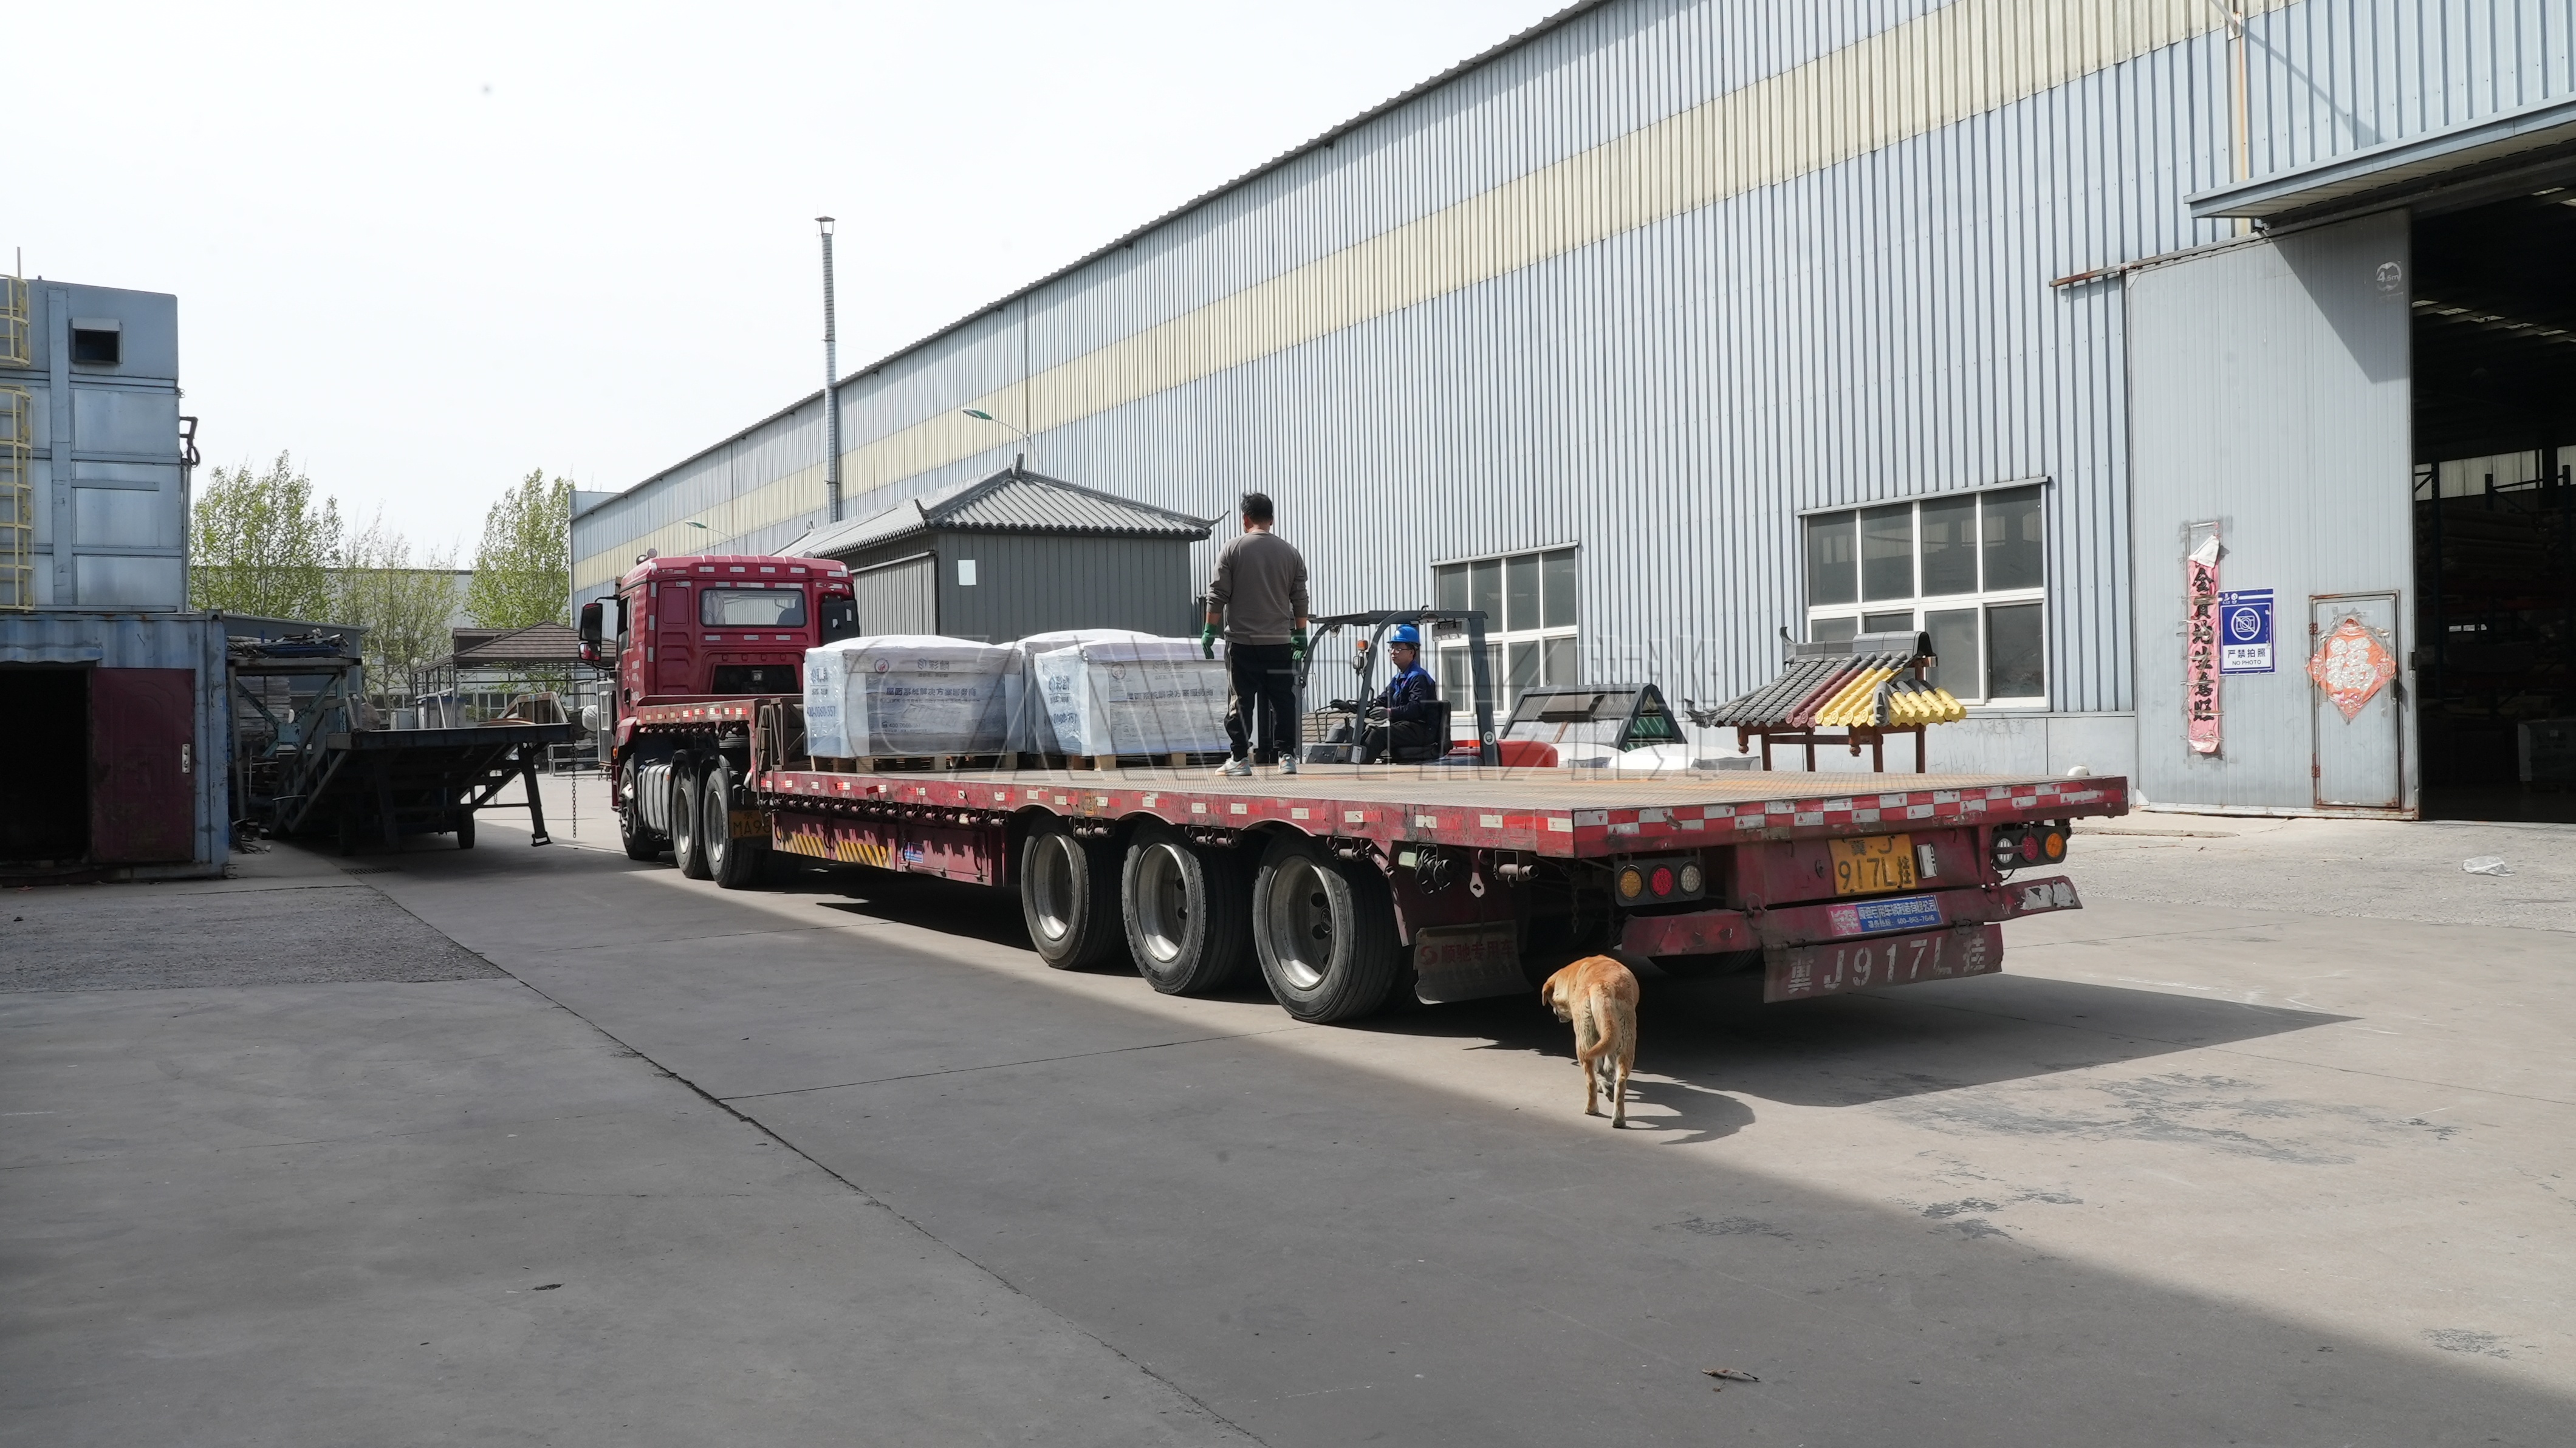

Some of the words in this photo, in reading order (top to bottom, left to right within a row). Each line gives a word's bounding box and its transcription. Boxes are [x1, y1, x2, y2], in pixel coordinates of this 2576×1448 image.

[2227, 648, 2266, 658] 严禁拍照
[733, 820, 771, 835] MA96
[1838, 855, 1912, 890] 917L挂
